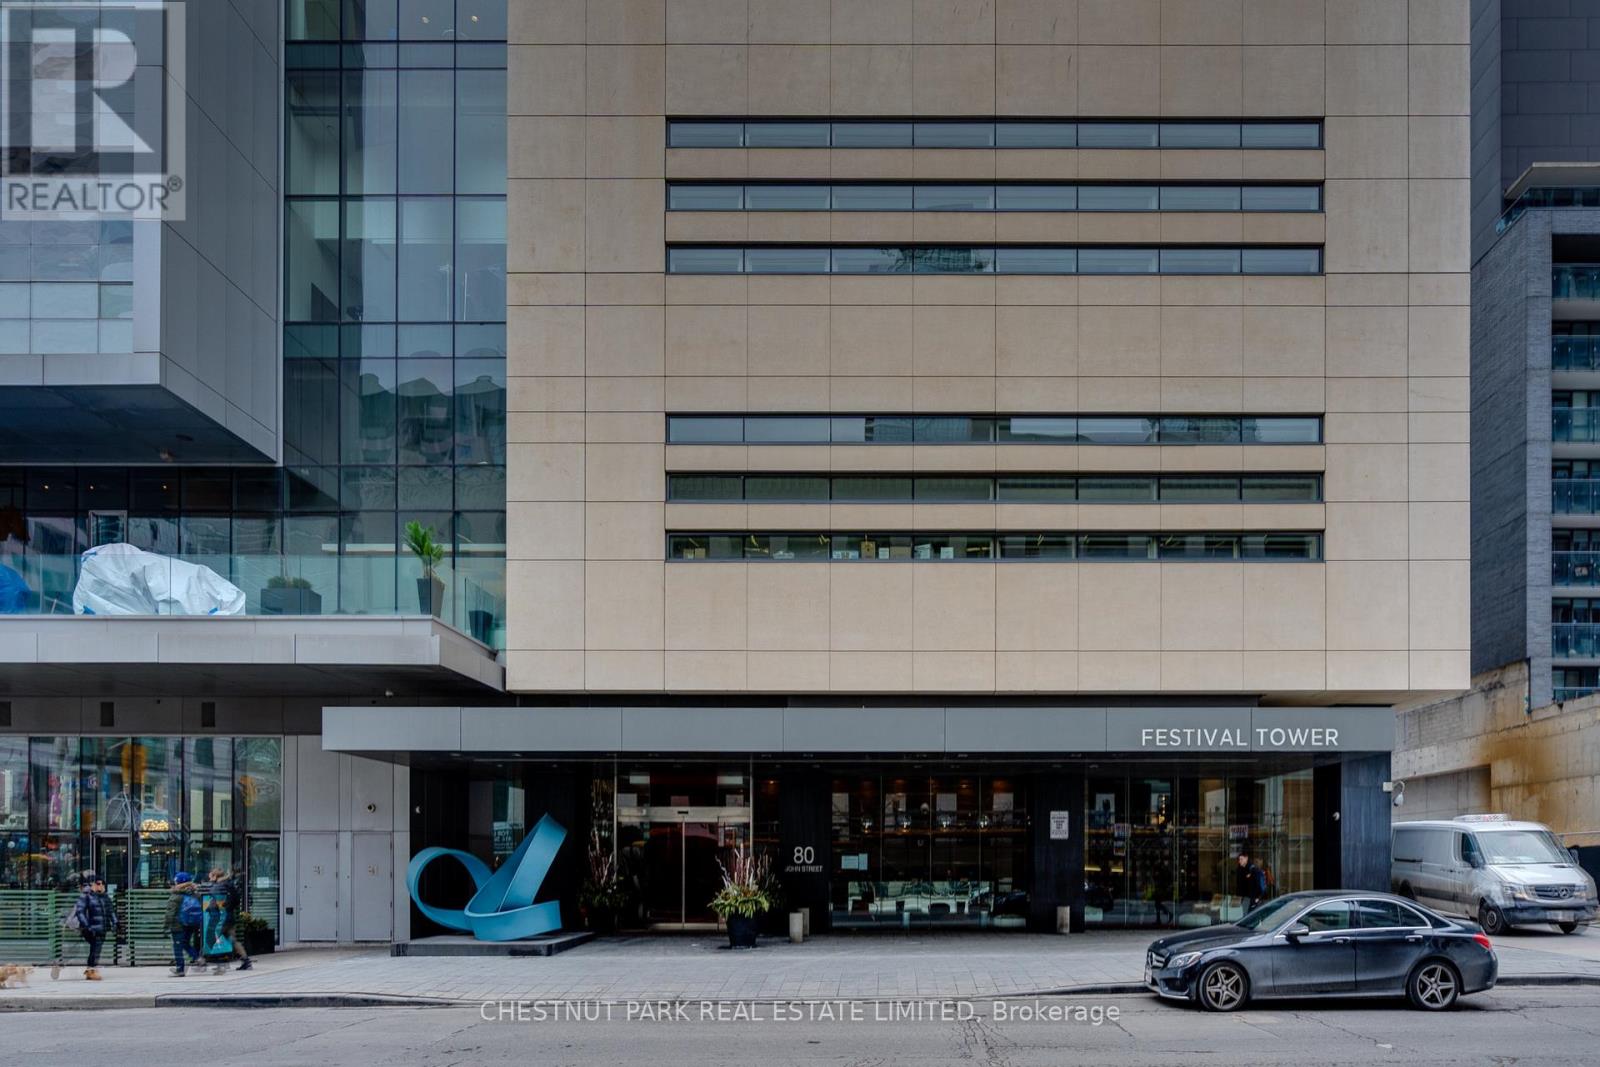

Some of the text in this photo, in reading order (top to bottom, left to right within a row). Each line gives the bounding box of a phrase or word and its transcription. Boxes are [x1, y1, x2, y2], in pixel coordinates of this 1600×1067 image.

[1141, 728, 1340, 746] FESTIVAL TOWER
[793, 846, 815, 864] 80
